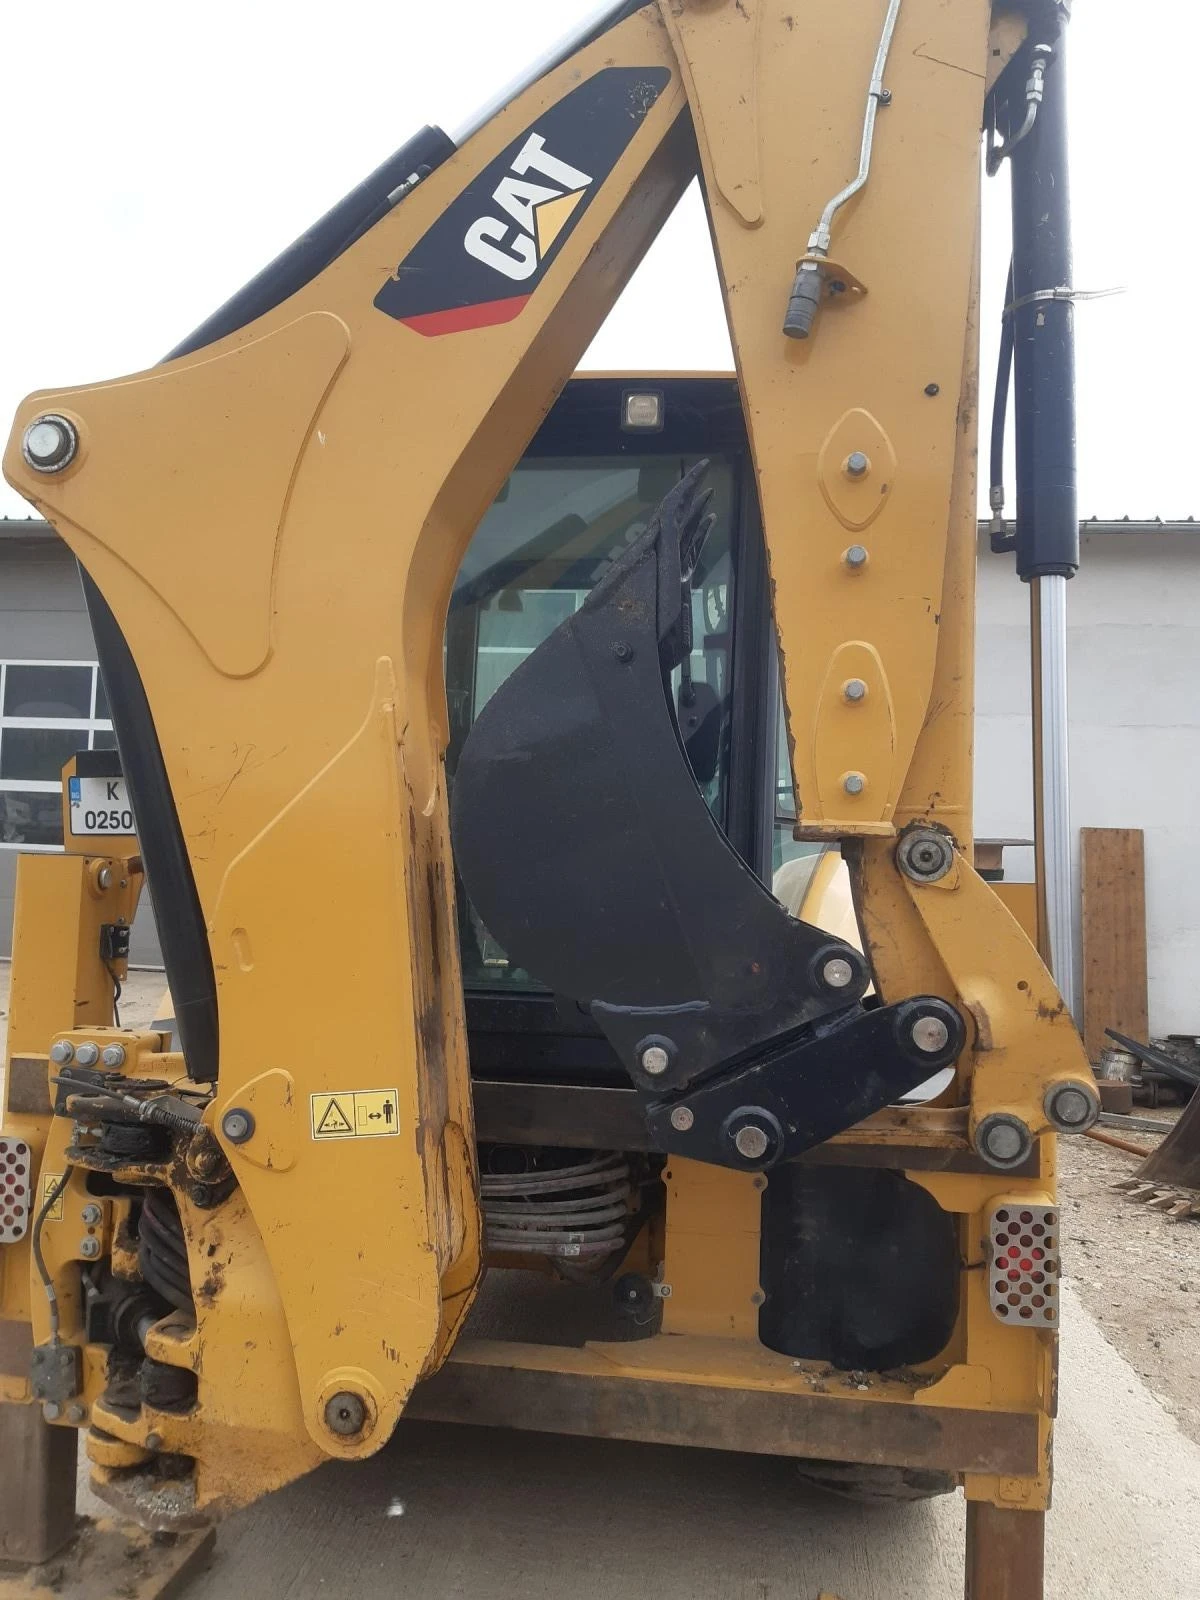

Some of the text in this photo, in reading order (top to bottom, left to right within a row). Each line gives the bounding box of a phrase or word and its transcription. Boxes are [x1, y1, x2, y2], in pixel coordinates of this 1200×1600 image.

[464, 132, 594, 280] CAT
[106, 781, 119, 800] K
[84, 810, 133, 830] 0250
